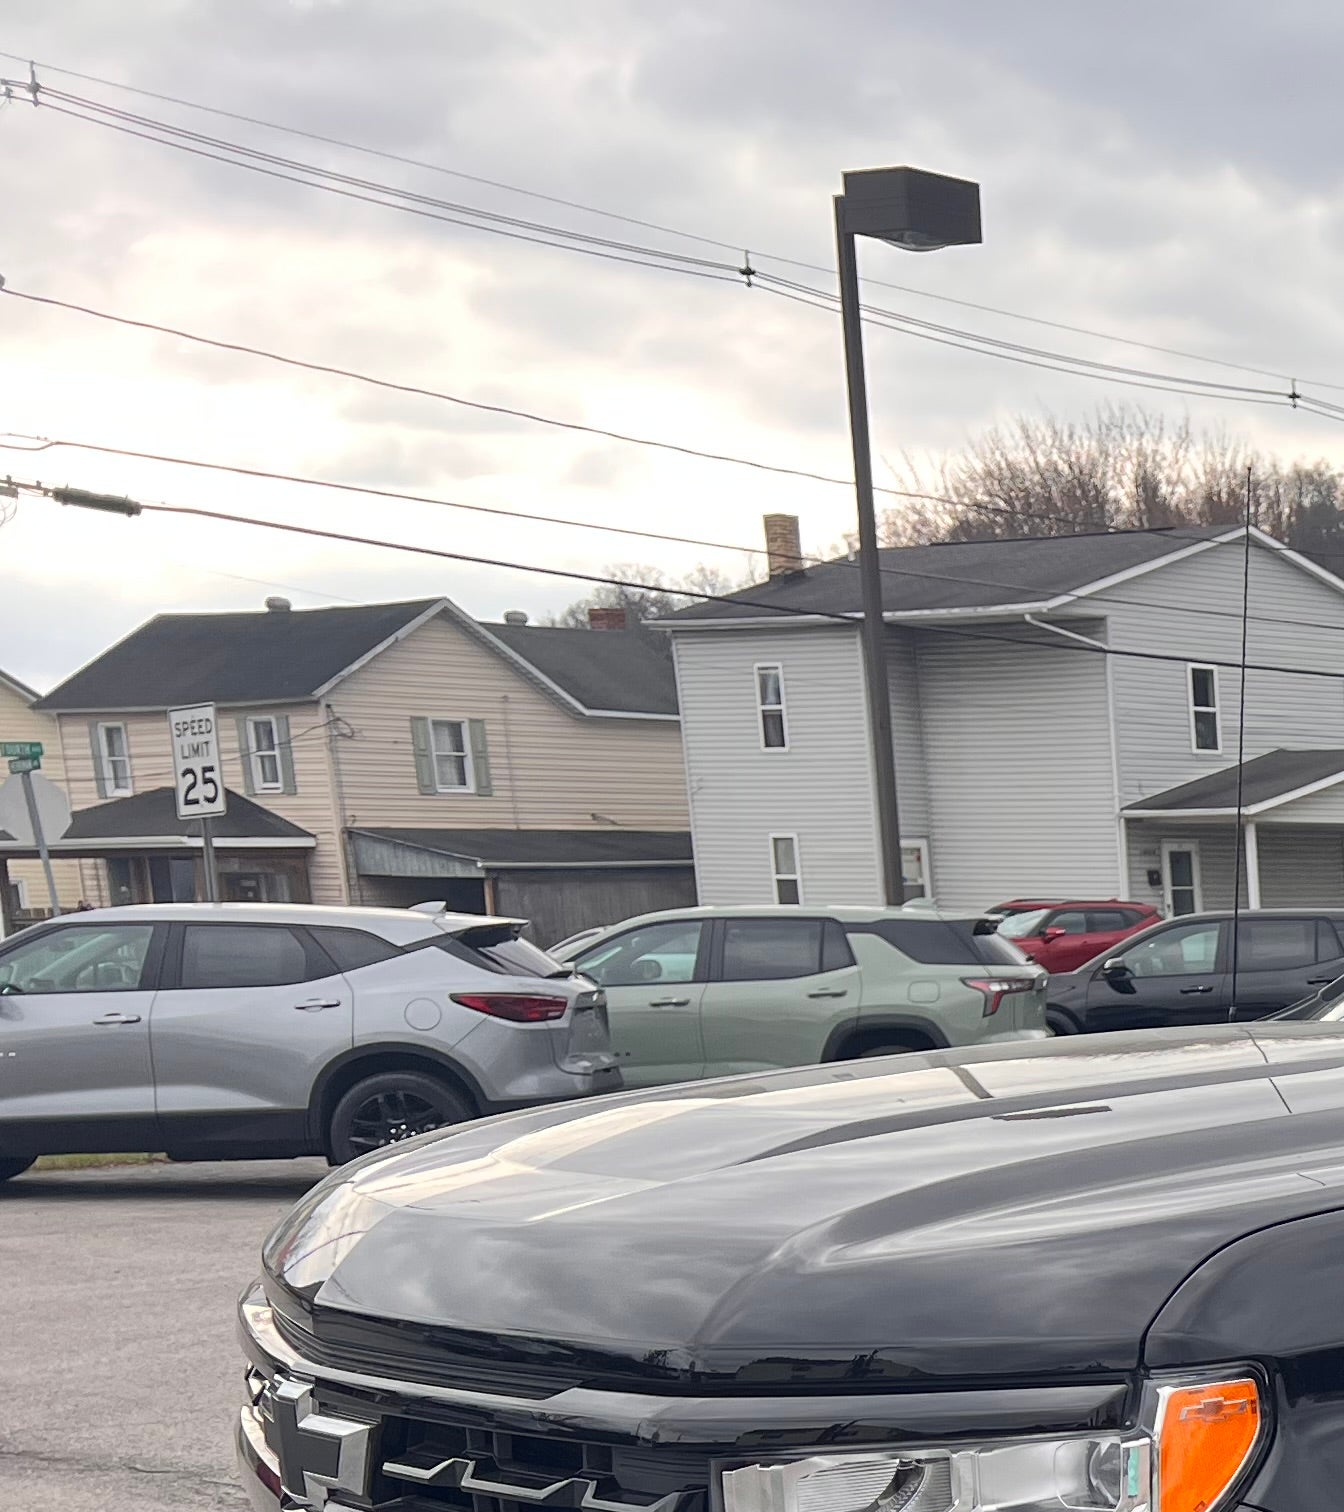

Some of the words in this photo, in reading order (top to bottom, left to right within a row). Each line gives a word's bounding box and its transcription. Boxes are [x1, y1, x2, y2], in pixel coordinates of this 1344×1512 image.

[174, 718, 213, 738] SPEED
[181, 741, 211, 760] LIMIT
[181, 765, 219, 806] 25
